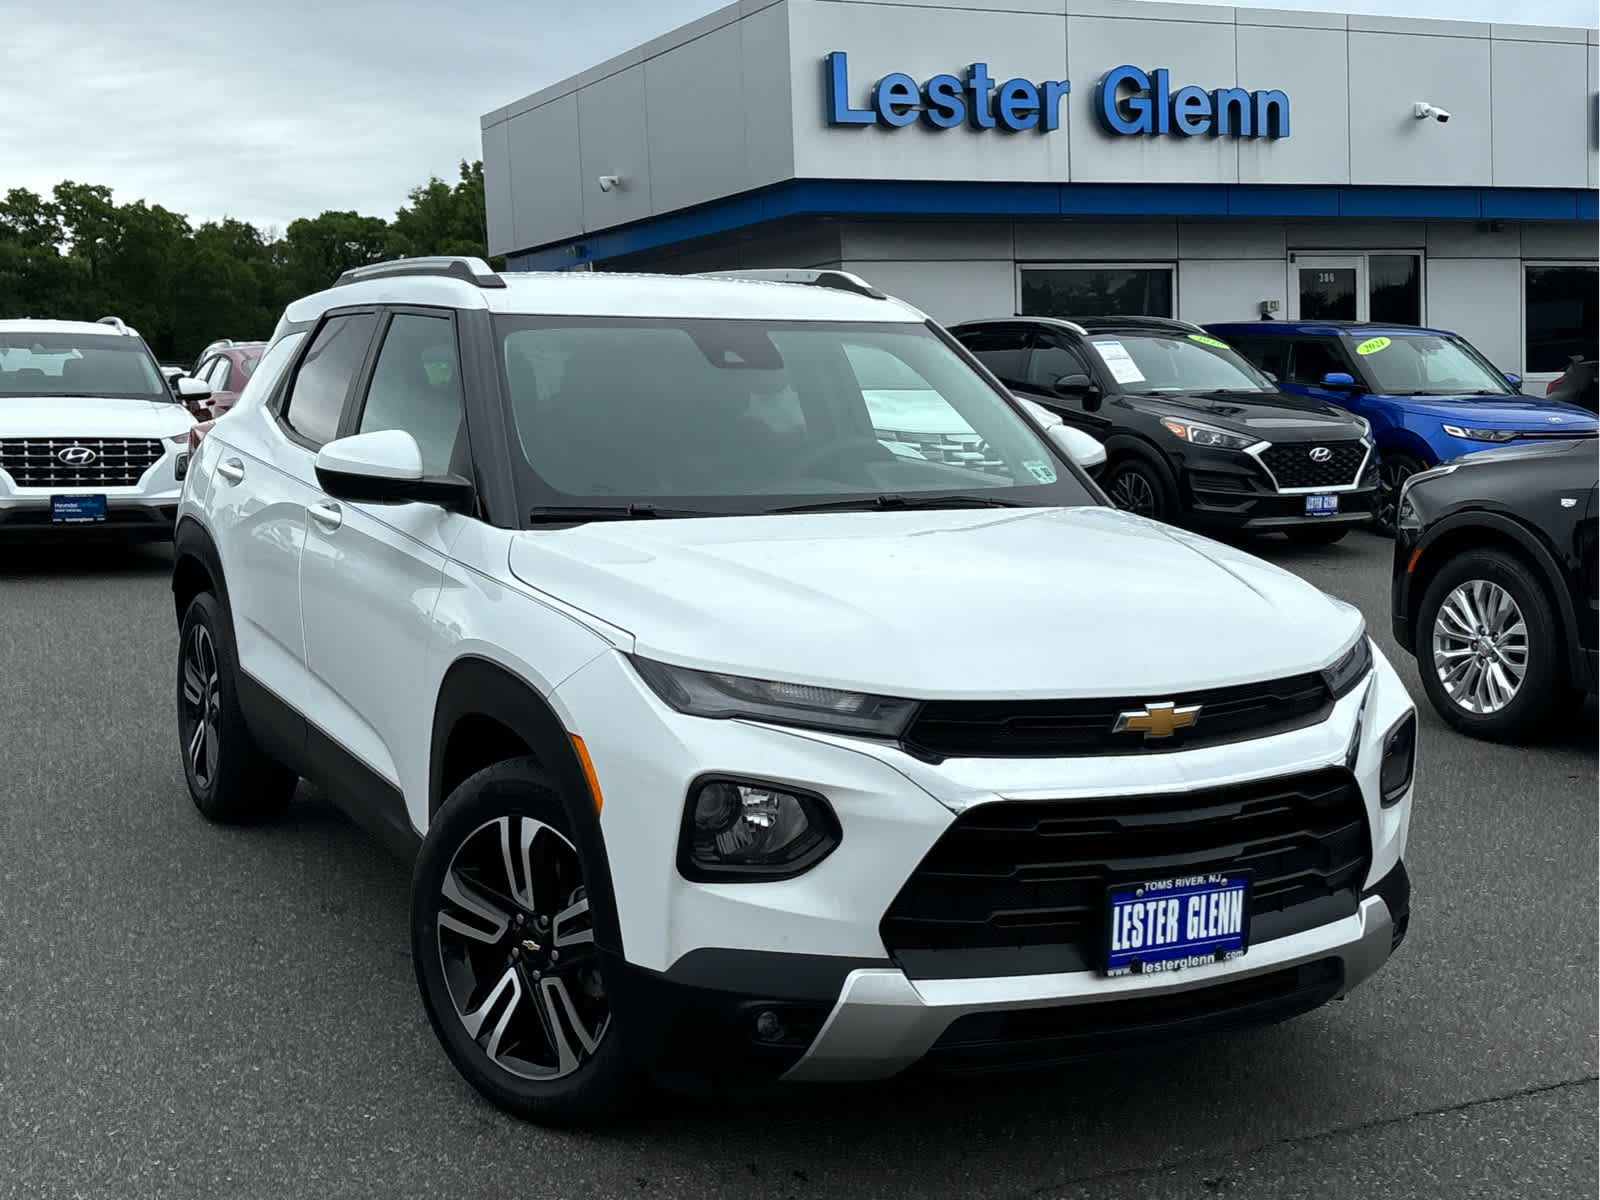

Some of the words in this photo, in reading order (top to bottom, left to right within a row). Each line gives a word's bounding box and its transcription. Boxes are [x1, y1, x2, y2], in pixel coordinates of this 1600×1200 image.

[824, 51, 1071, 132] Lester
[1094, 64, 1290, 140] Glenn
[1363, 338, 1385, 353] 2021
[1144, 879, 1173, 891] TOMS
[1208, 874, 1222, 883] NJ
[1112, 899, 1179, 951] LESTER
[1186, 889, 1244, 940] GLENN
[1142, 954, 1215, 974] lesterglenn
